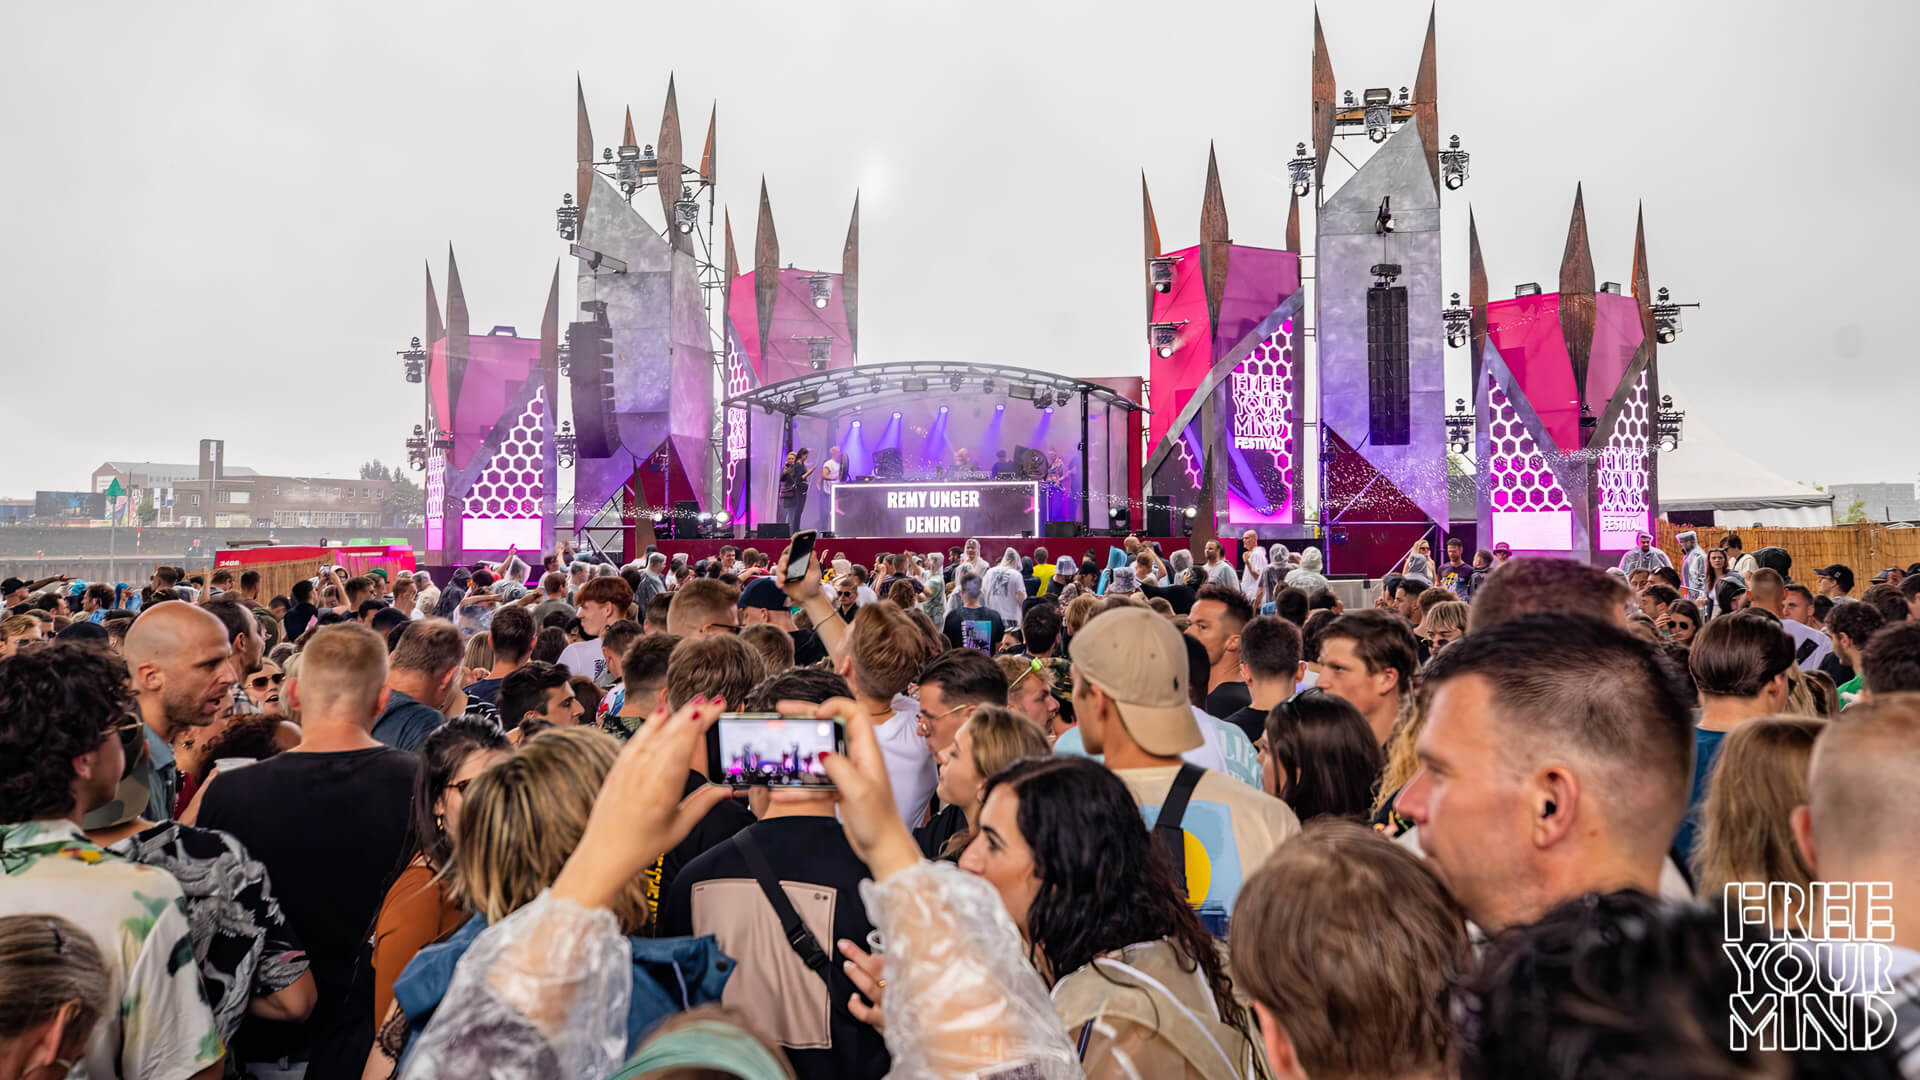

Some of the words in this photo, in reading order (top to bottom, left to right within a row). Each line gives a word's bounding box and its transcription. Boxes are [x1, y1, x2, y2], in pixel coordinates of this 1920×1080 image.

[1235, 437, 1284, 450] FESTIVAL
[887, 491, 926, 509] REMY
[929, 491, 980, 508] UNGER
[905, 515, 961, 534] DENIRO
